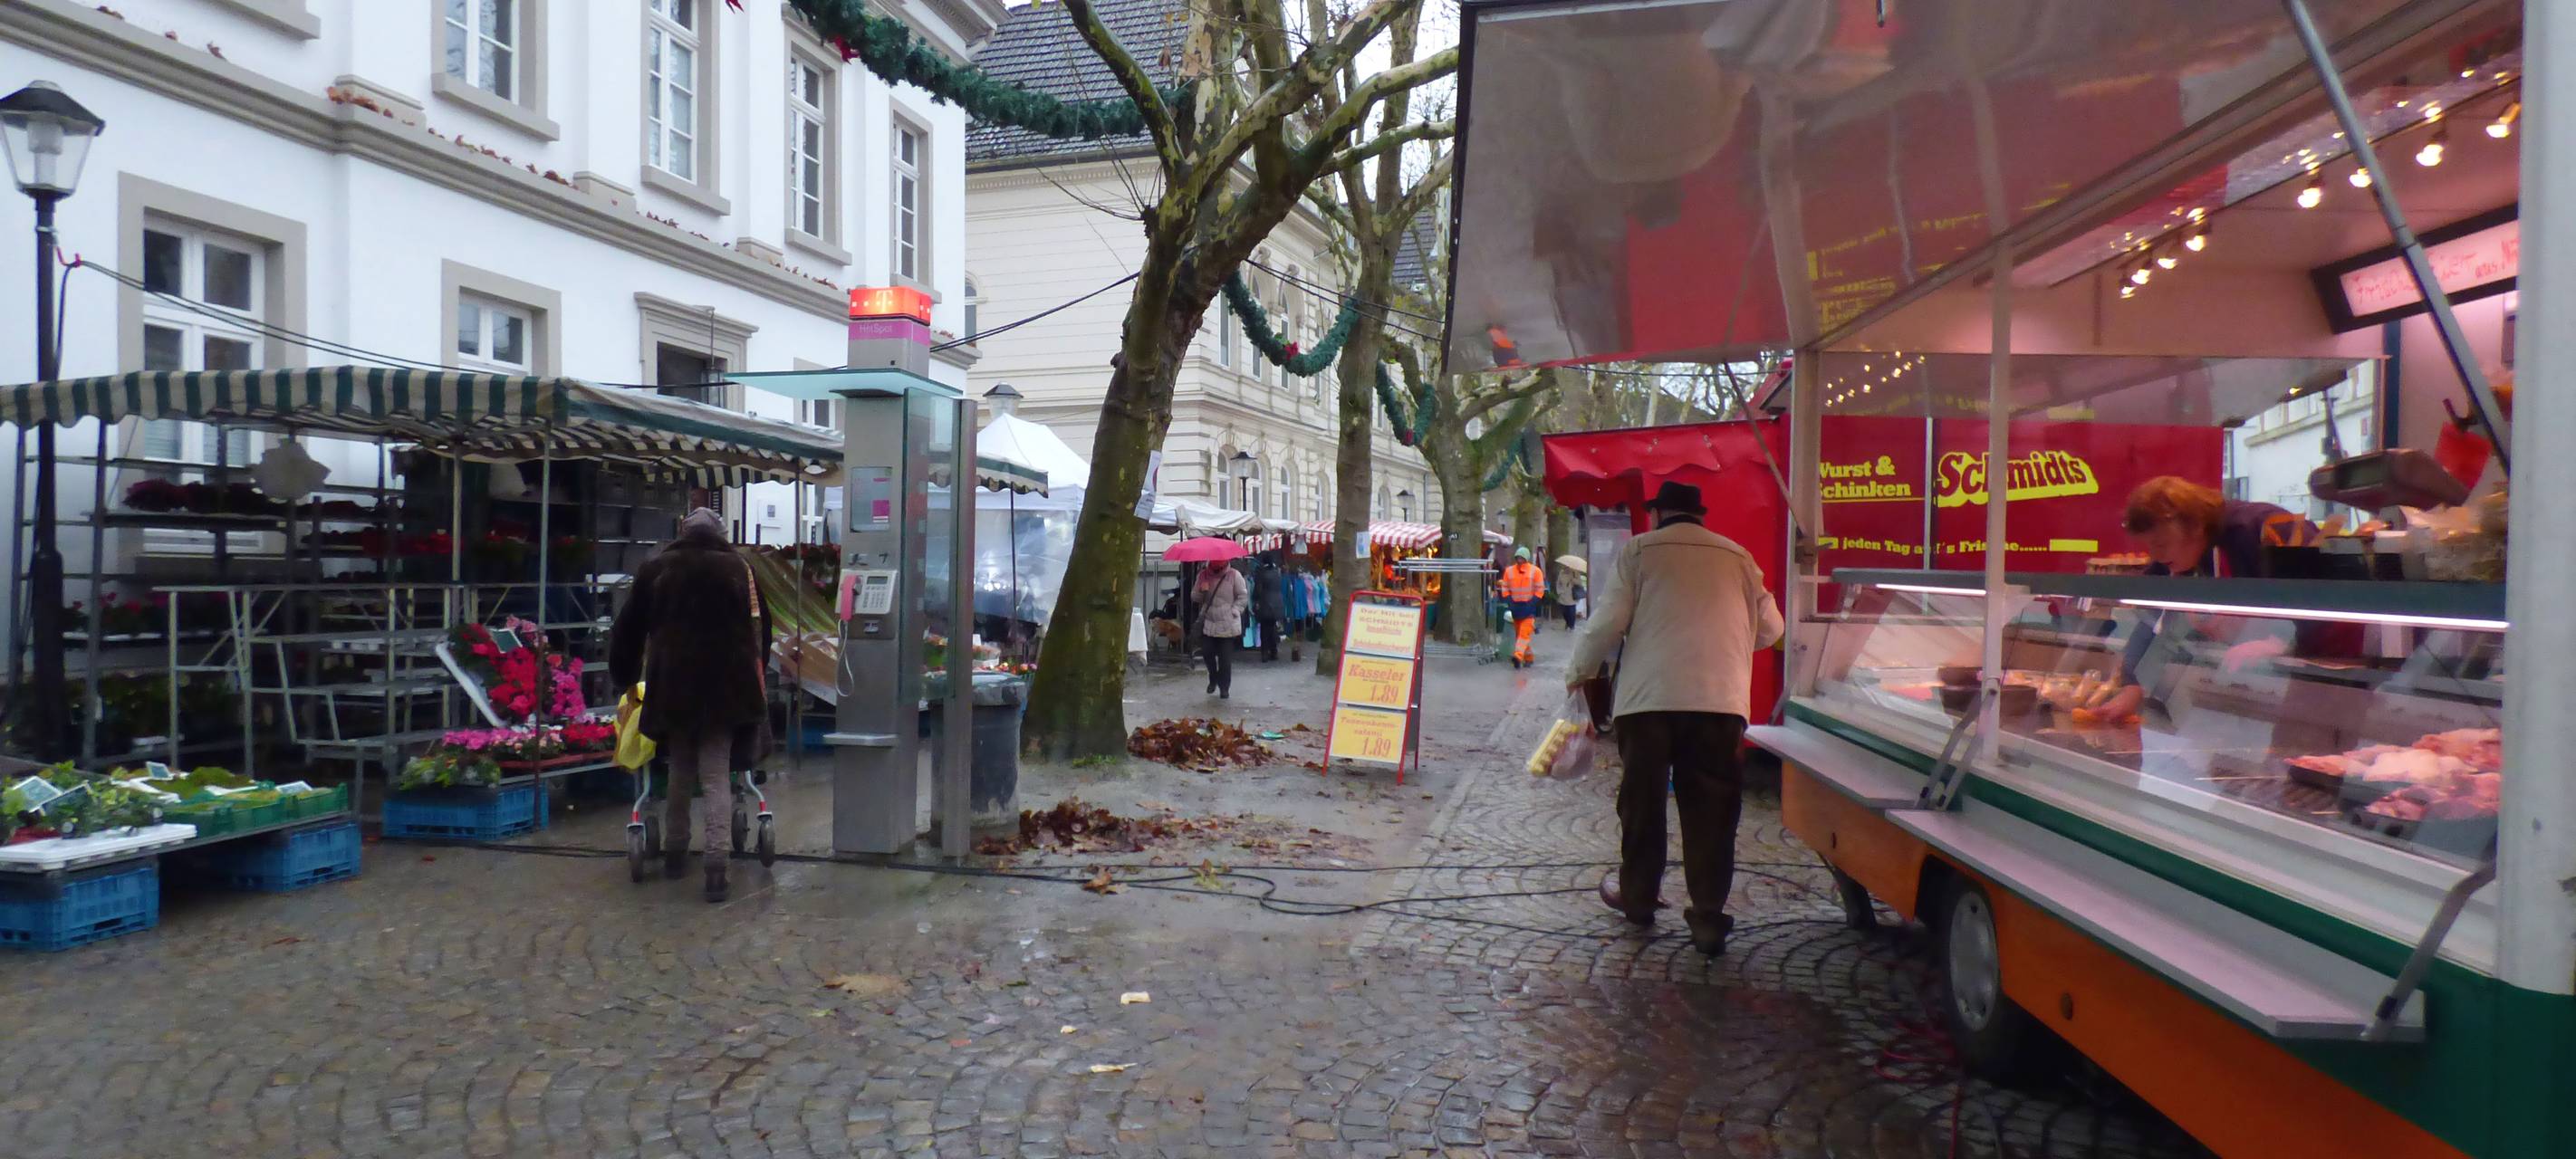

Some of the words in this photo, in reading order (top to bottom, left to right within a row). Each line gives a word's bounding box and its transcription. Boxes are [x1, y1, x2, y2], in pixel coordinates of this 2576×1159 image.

[1875, 455, 1896, 475] &
[1820, 481, 1911, 498] chinken
[1884, 540, 1910, 555] Tag
[1348, 664, 1406, 682] Kasseler
[1370, 683, 1399, 704] 1.89
[1361, 736, 1391, 758] 1.89
